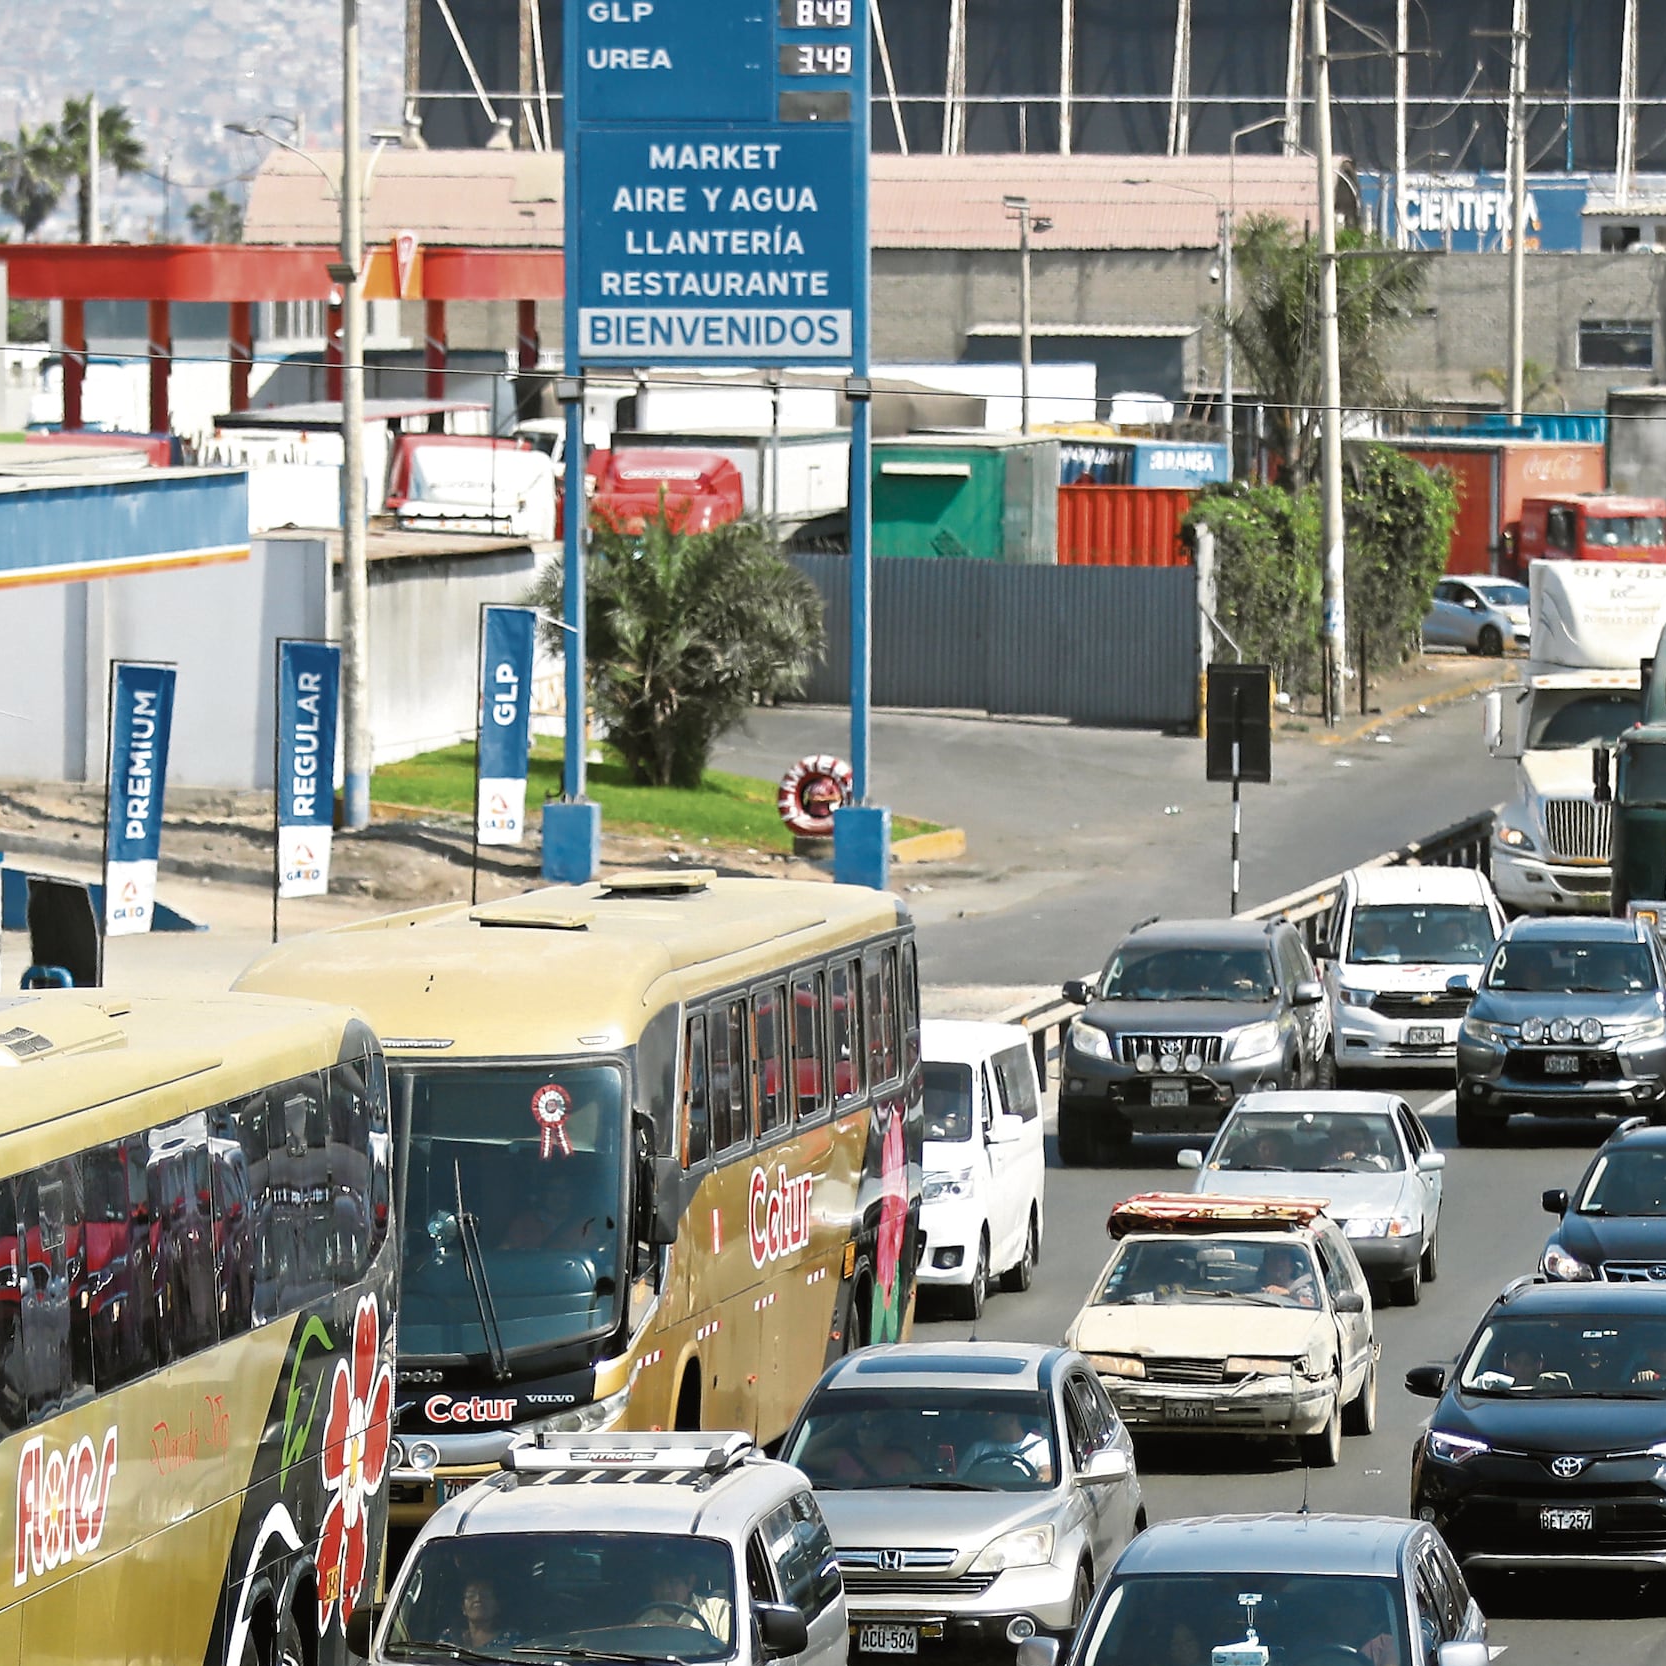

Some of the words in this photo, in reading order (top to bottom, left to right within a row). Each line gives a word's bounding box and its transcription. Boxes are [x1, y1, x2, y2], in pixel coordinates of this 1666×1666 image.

[588, 2, 653, 23] GLP
[586, 48, 673, 69] UREA
[649, 144, 781, 170] MARKET
[612, 187, 686, 212] AIRE
[703, 187, 722, 212] Y
[730, 187, 818, 212] AGUA
[626, 225, 804, 255] LLANTERÍA
[601, 272, 829, 296] RESTAURANTE
[589, 315, 839, 346] BIENVENIDOS
[493, 663, 519, 725] GLP
[293, 671, 321, 816] REGULAR
[126, 689, 158, 840] PREMIUM
[748, 1165, 813, 1270] Cetur
[425, 1394, 519, 1423] Cetur
[525, 1395, 575, 1404] VOLVO
[1541, 1513, 1591, 1530] BET-257
[861, 1630, 914, 1649] ACU-504
